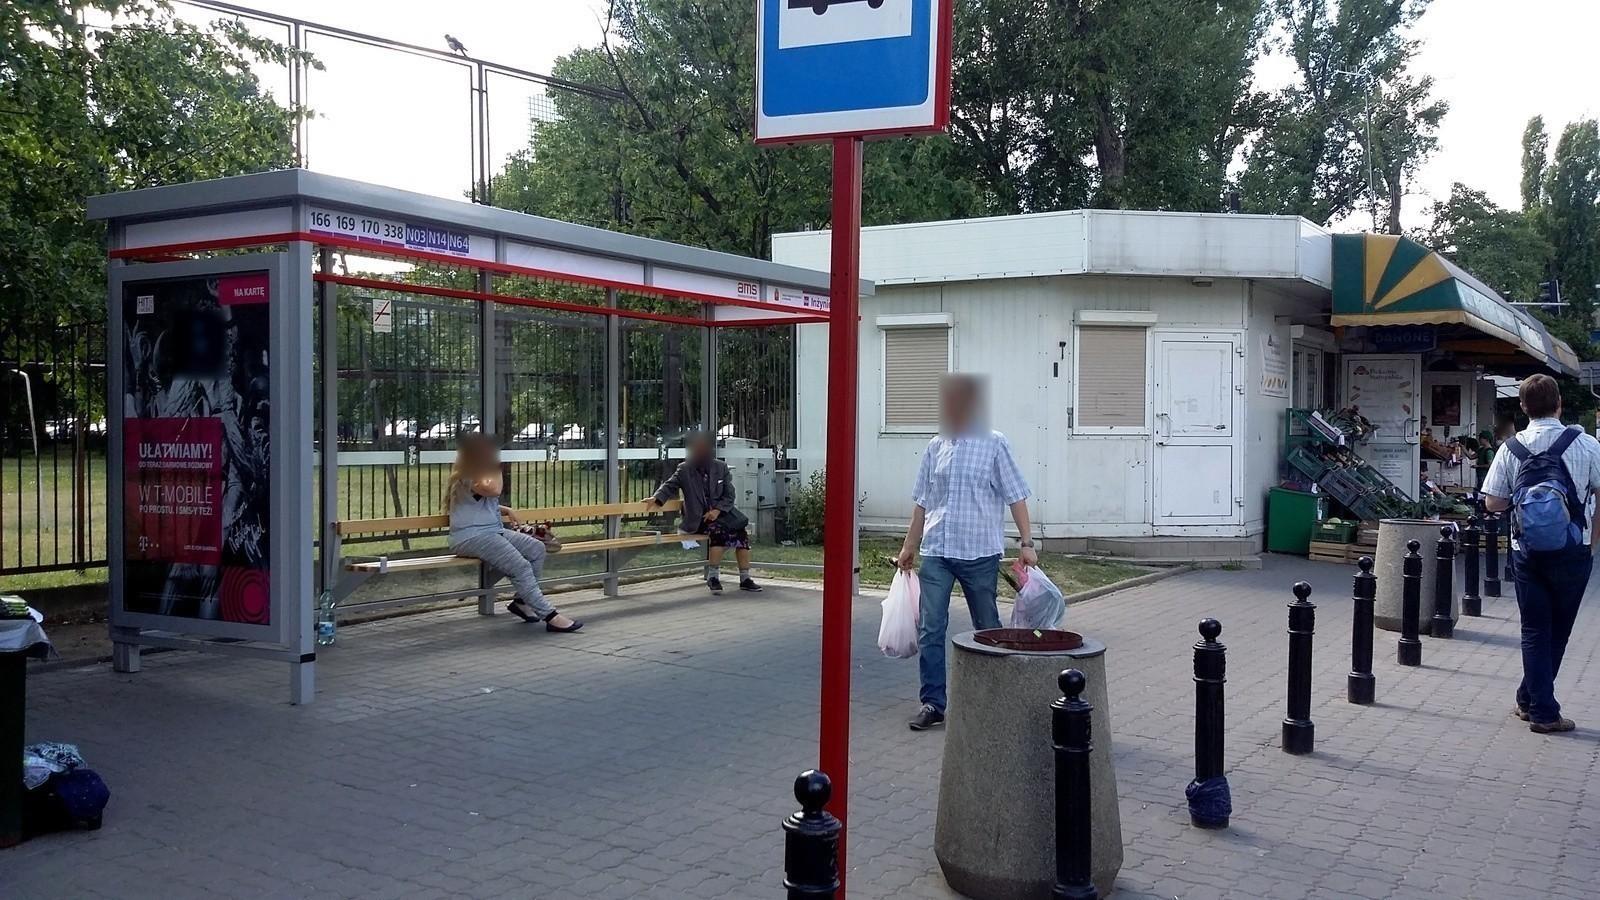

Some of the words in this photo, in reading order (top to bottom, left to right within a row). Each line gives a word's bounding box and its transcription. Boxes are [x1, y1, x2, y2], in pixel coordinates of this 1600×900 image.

[310, 211, 331, 228] 166
[336, 215, 356, 231] 169
[361, 219, 380, 235] 170
[384, 223, 404, 240] 338
[406, 228, 426, 244] N03
[428, 231, 447, 246] N14
[450, 235, 469, 249] N64
[233, 287, 244, 297] NA
[244, 286, 265, 297] KARTĘ
[737, 282, 758, 295] ams
[811, 296, 830, 310] Inżyni
[139, 442, 213, 459] UŁATWIAMY!
[139, 485, 151, 501] W
[153, 485, 213, 504] T-MOBILE
[139, 504, 148, 513] PO
